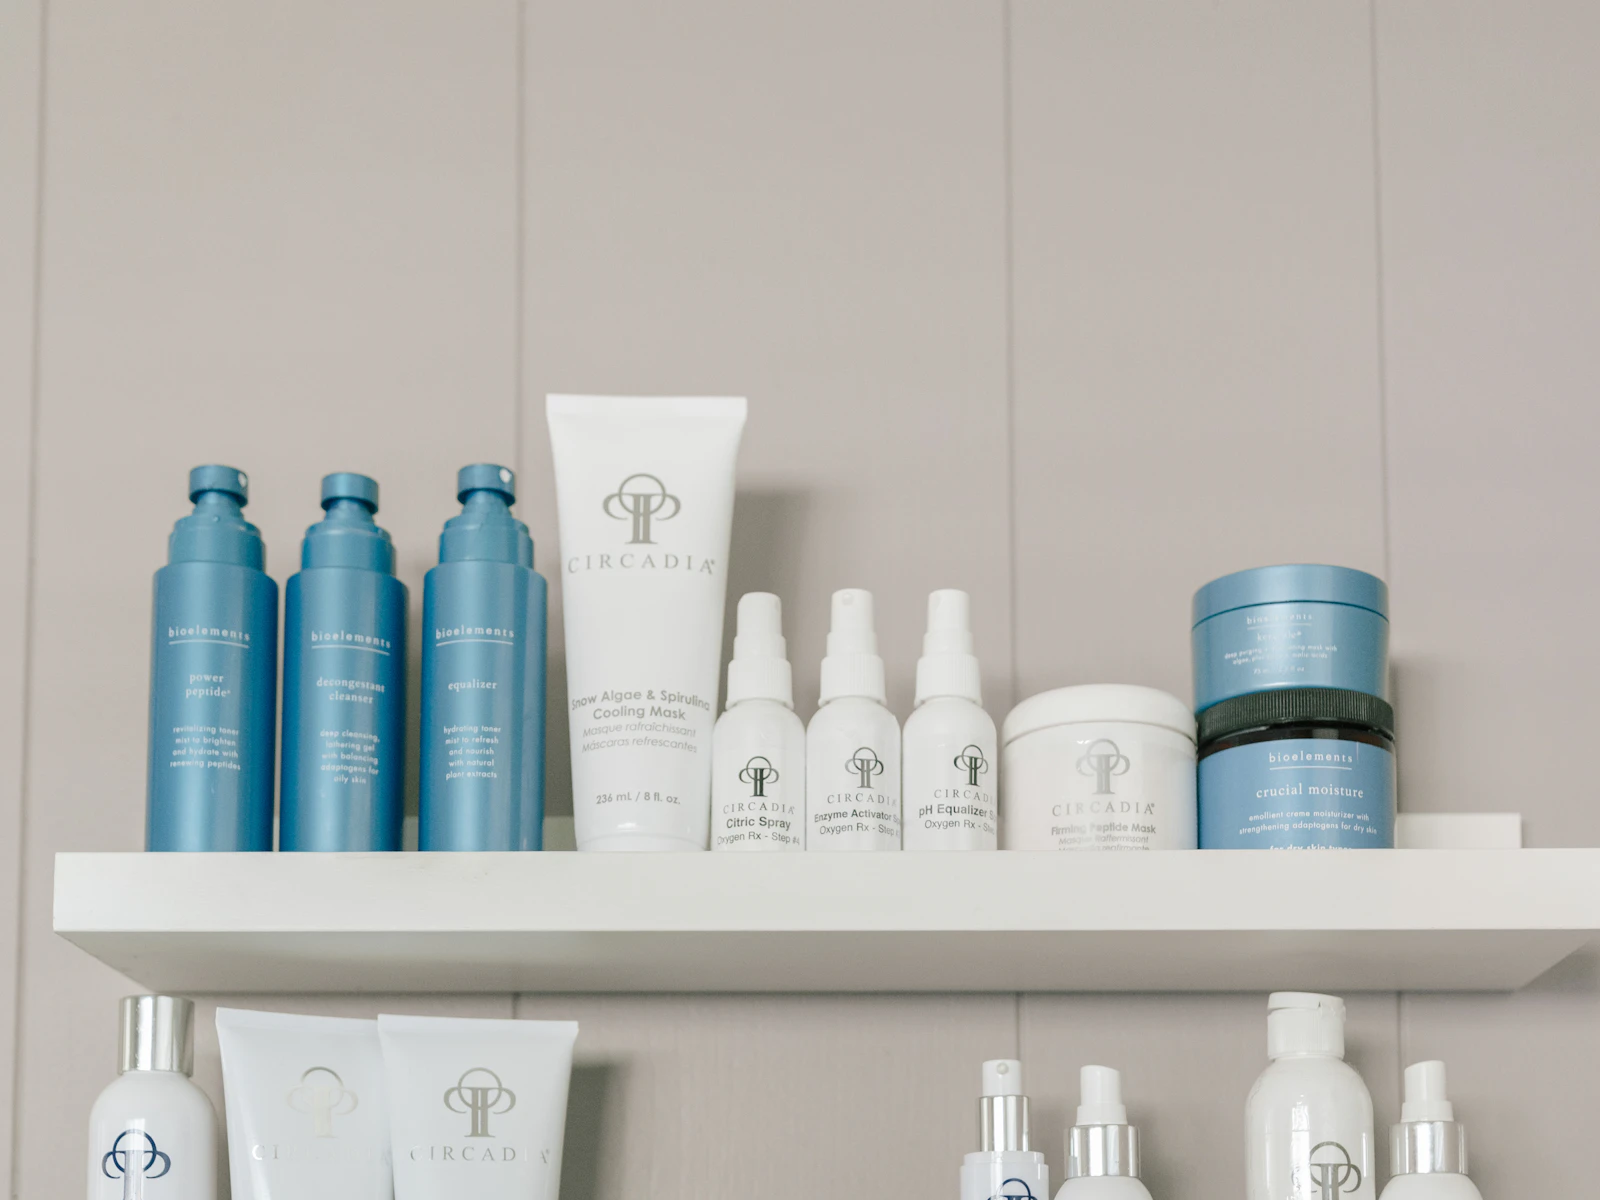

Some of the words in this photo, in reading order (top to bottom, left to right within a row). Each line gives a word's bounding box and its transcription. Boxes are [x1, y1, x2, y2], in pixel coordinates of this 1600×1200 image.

[168, 625, 250, 641] bioelements
[436, 624, 515, 640] bioelements
[311, 630, 391, 649] bioelements
[189, 673, 224, 684] power
[316, 676, 386, 693] decongestant
[448, 679, 498, 692] equalizer
[329, 690, 374, 704] cleanser
[571, 695, 598, 711] Snow
[600, 689, 642, 704] Algae
[646, 689, 656, 700] &
[660, 690, 710, 711] Spirulina
[593, 706, 645, 720] Cooling
[649, 706, 686, 720] Mask
[173, 725, 216, 735] revitalizing
[219, 727, 239, 736] toner
[320, 729, 340, 738] deep
[443, 725, 479, 735] hydrating
[481, 725, 501, 733] toner
[583, 722, 623, 738] Masque
[203, 736, 236, 747] brighten
[326, 740, 361, 752] lathering
[472, 736, 499, 744] refresh
[581, 737, 630, 753] Máscaras
[632, 736, 698, 753] refrescantes
[172, 748, 187, 756] and
[189, 748, 220, 758] hydrate
[222, 749, 238, 758] with
[449, 748, 463, 756] and
[466, 747, 495, 755] nourish
[1268, 750, 1354, 763] bioelements
[169, 759, 205, 769] renewing
[207, 760, 241, 771] peptides
[340, 752, 379, 766] balancing
[449, 759, 464, 767] with
[466, 758, 495, 767] natural
[320, 764, 367, 774] adaptogens
[445, 771, 464, 781] plant
[467, 770, 497, 779] extracts
[333, 774, 349, 784] oily
[352, 774, 367, 784] skin
[1256, 782, 1303, 798] crucial
[1308, 784, 1364, 798] moisture
[596, 793, 613, 805] 236
[616, 791, 632, 802] mL
[814, 809, 848, 823] Enzyme
[851, 808, 891, 821] Activator
[919, 804, 933, 818] pH
[937, 803, 987, 817] Equalizer
[1248, 811, 1284, 822] emollient
[1313, 810, 1354, 820] moisturizer
[1356, 813, 1370, 822] with
[726, 816, 755, 829] Citric
[758, 816, 791, 831] Spray
[819, 823, 853, 835] Oxygen
[856, 822, 870, 832] Rx
[878, 824, 894, 837] Step
[924, 819, 960, 829] Oxygen
[963, 819, 976, 829] Rx
[1051, 824, 1087, 836] Firming
[1089, 822, 1129, 835] Peptide
[1131, 822, 1157, 834] Mask
[1239, 821, 1290, 835] strengthening
[1292, 821, 1339, 831] adaptogens
[1353, 824, 1365, 834] dry
[717, 832, 745, 845] Oxygen
[748, 832, 762, 840] Rx
[771, 832, 791, 845] Step
